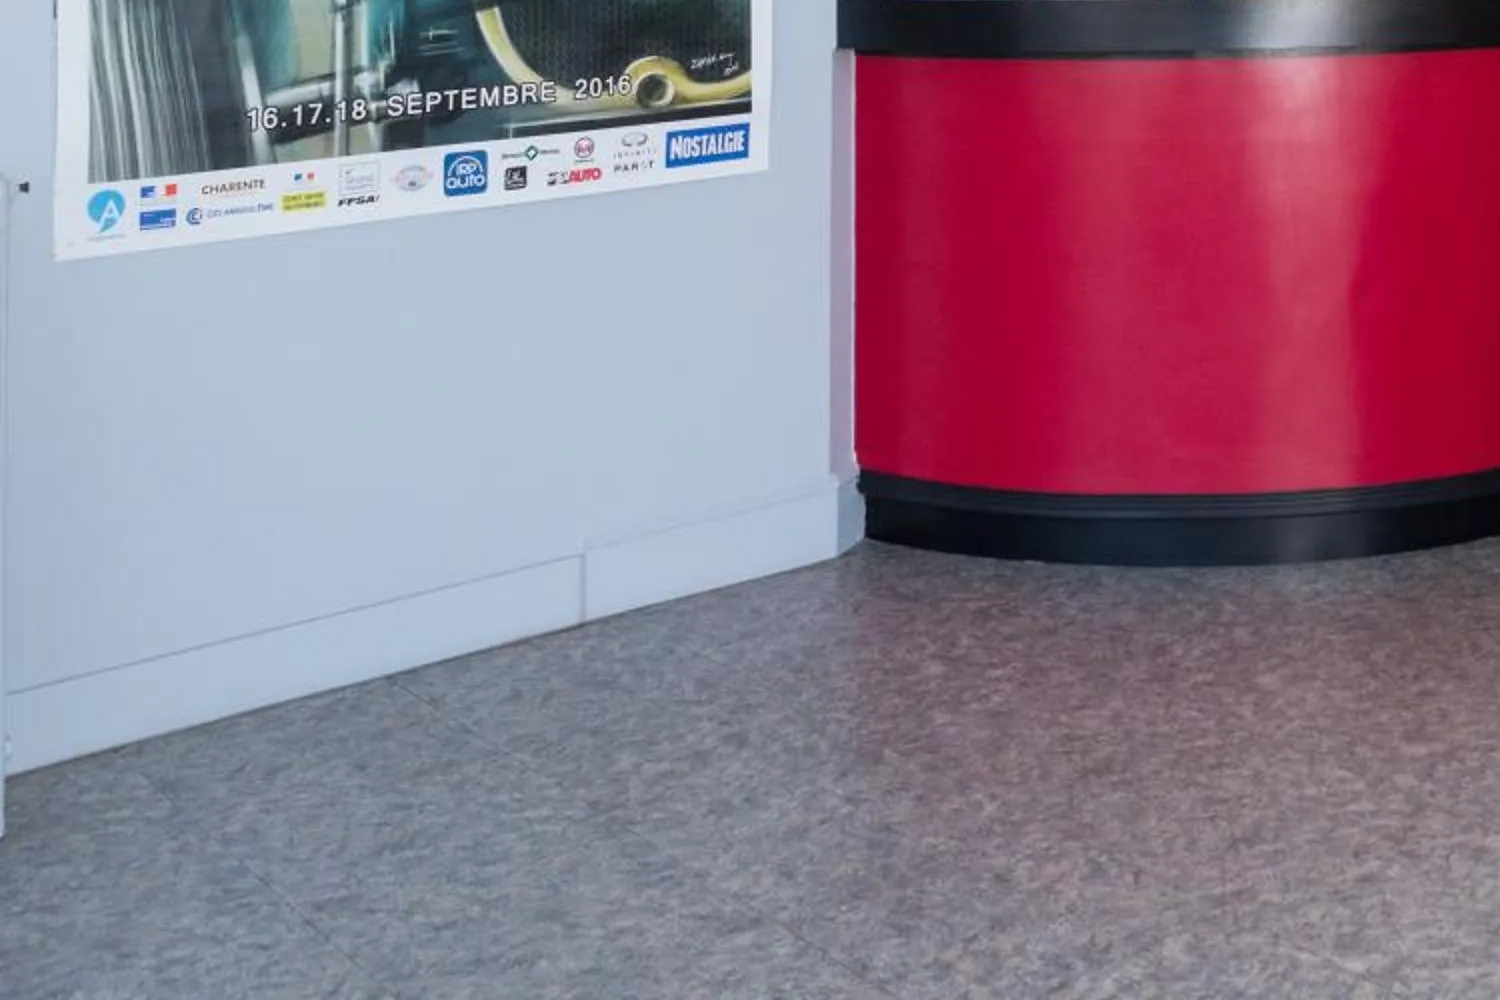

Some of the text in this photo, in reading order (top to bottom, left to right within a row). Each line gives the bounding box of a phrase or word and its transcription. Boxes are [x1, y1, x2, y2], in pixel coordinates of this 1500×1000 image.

[387, 79, 557, 117] SEPTEMBRE
[575, 73, 631, 98] 2016
[669, 129, 746, 162] NOSTALGIE
[201, 179, 266, 195] CHARENTE
[446, 173, 485, 189] auto
